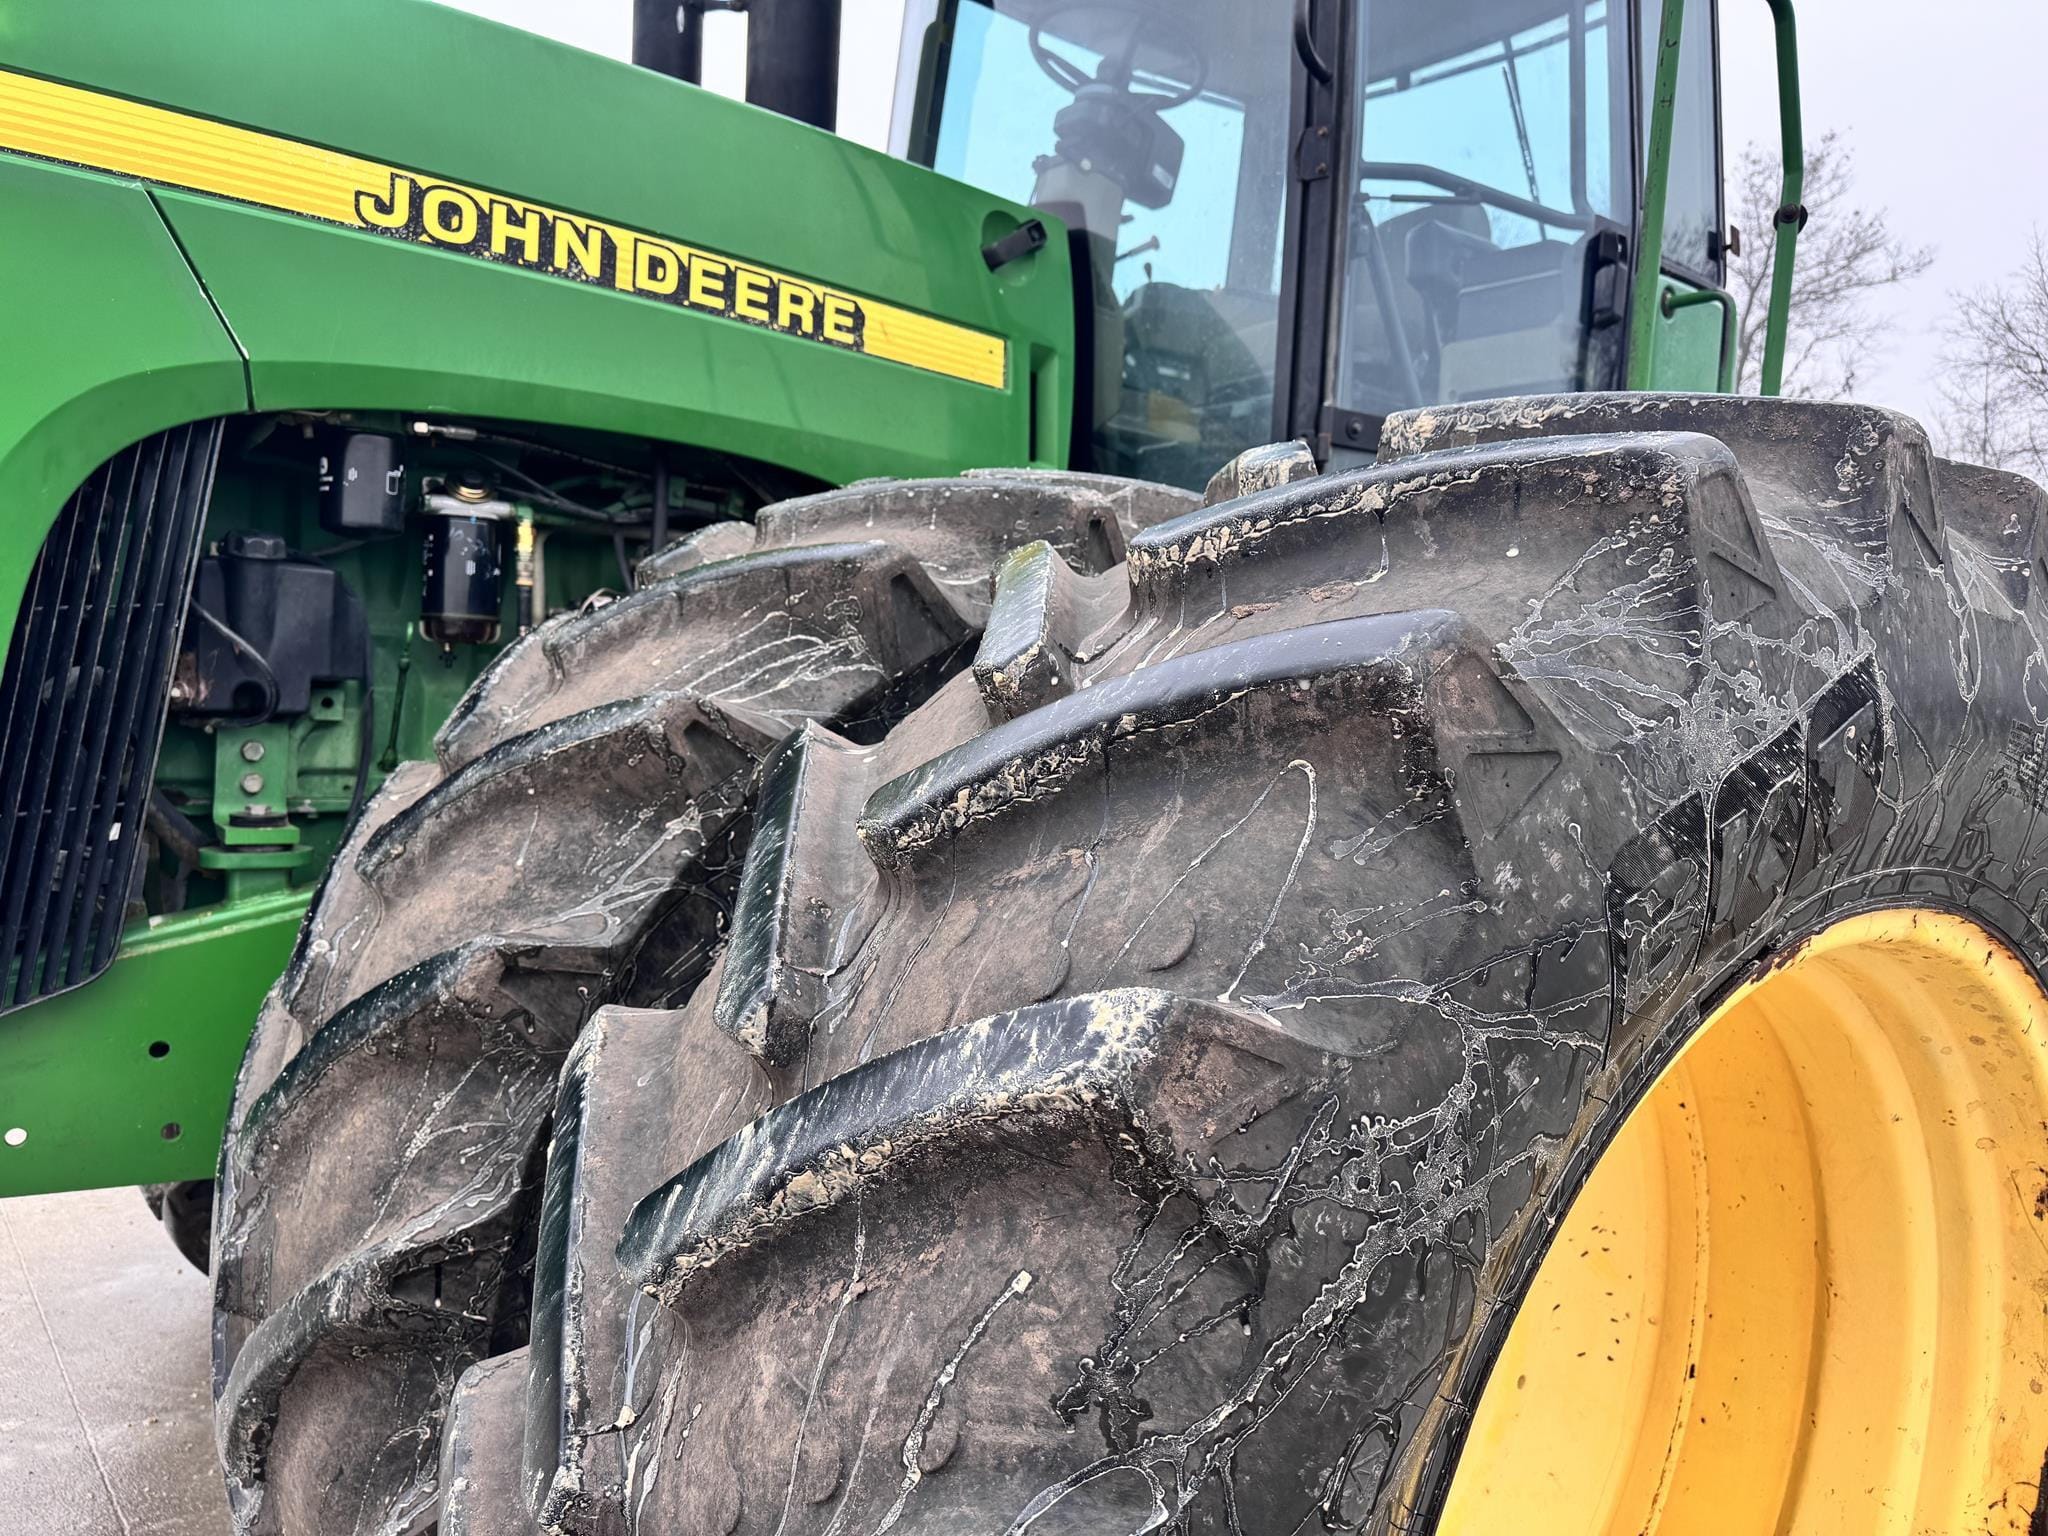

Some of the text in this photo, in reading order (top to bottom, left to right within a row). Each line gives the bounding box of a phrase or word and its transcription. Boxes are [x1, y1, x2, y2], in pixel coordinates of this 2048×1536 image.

[355, 172, 861, 347] JOHN DEERE
[1620, 699, 1874, 1022] BKT
